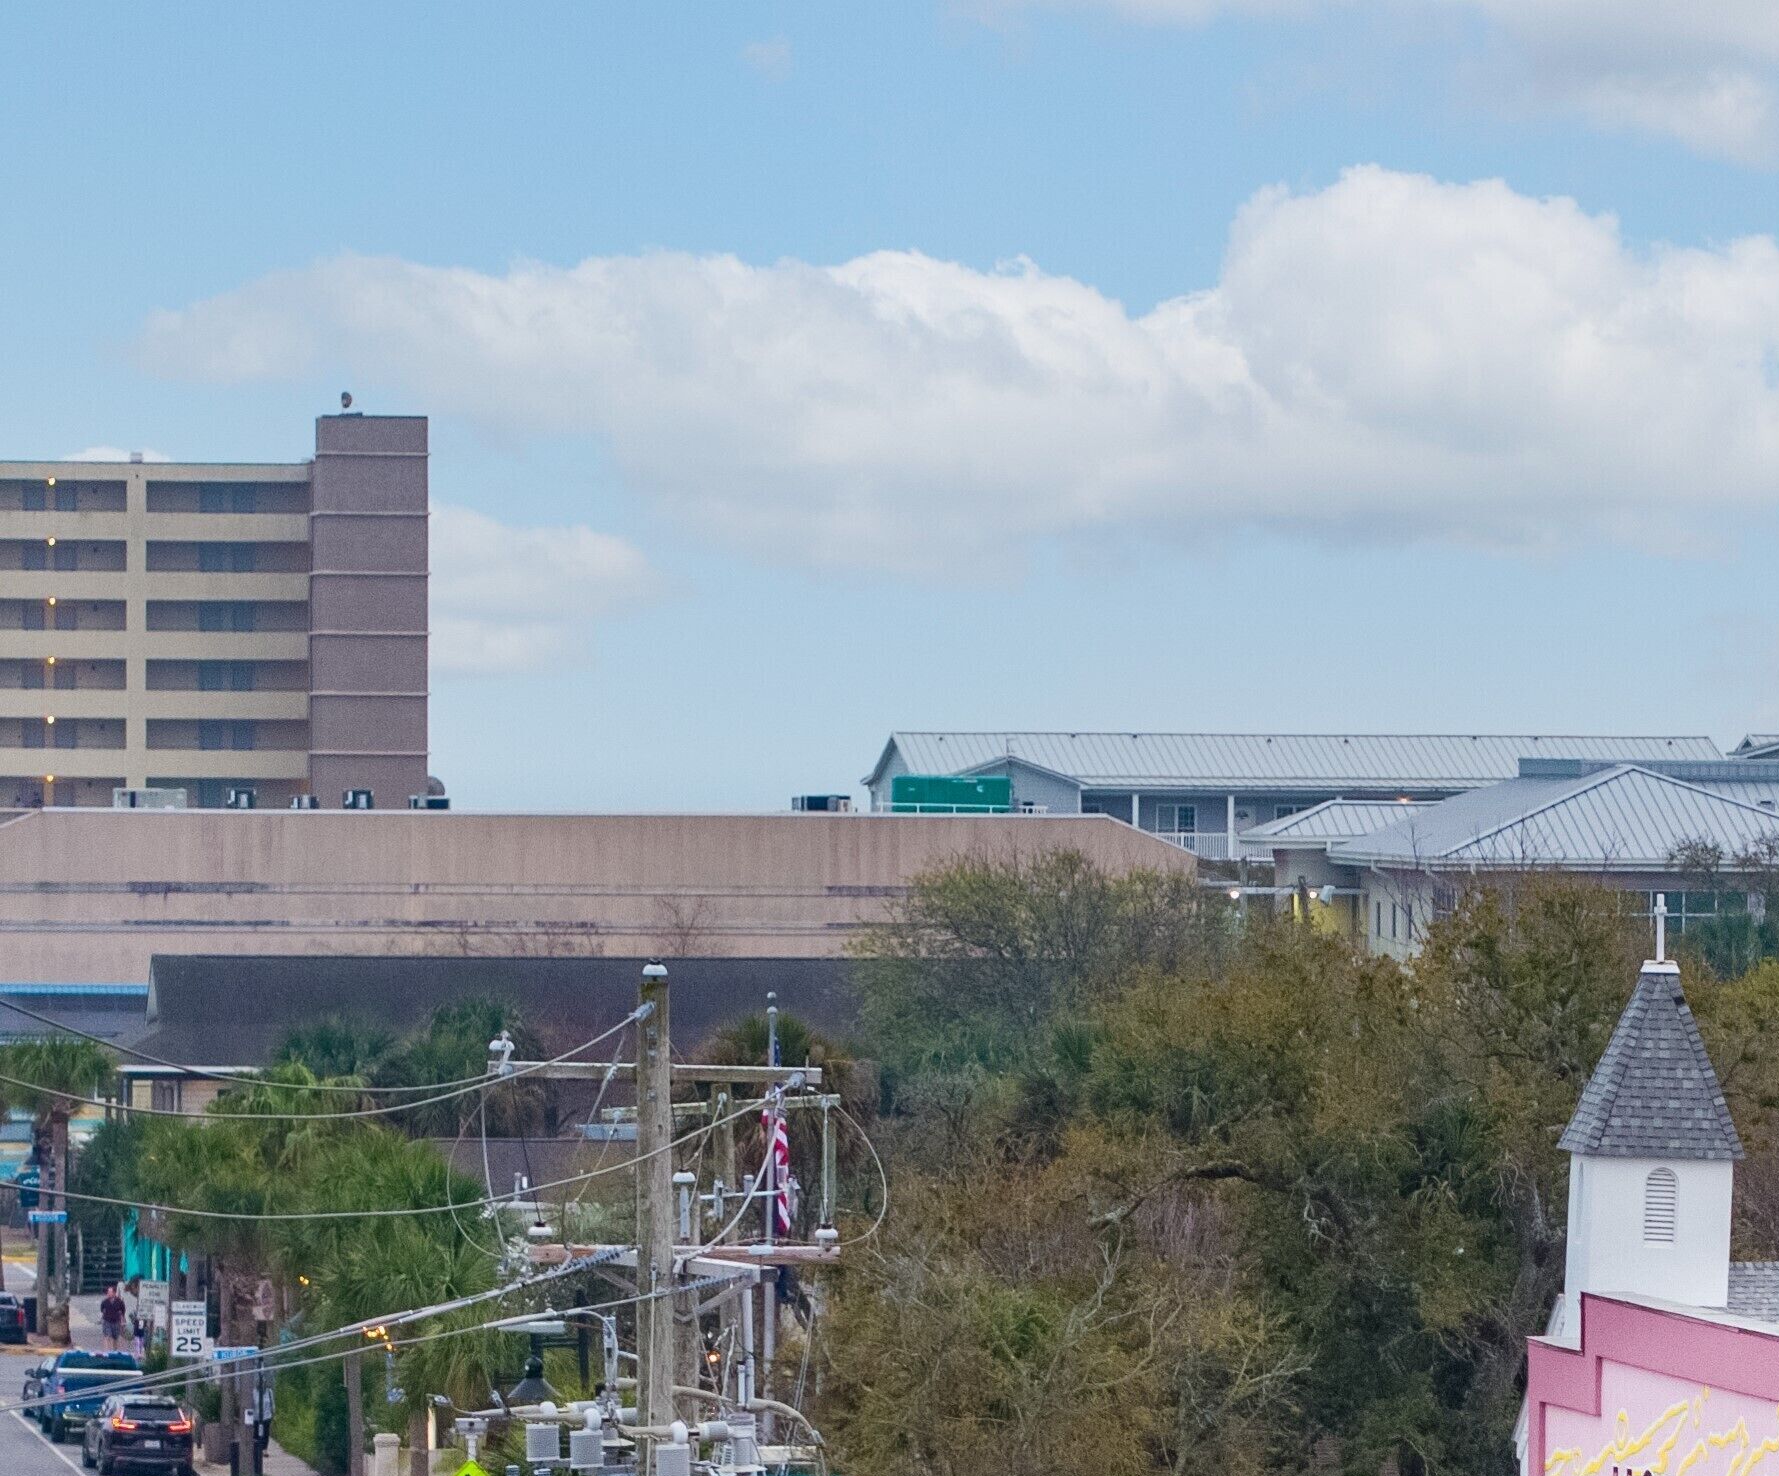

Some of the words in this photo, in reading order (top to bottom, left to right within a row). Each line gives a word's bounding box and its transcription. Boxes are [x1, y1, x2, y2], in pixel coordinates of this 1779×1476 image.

[174, 1318, 205, 1326] SPEED
[177, 1328, 200, 1336] LIMIT
[176, 1336, 202, 1352] 25
